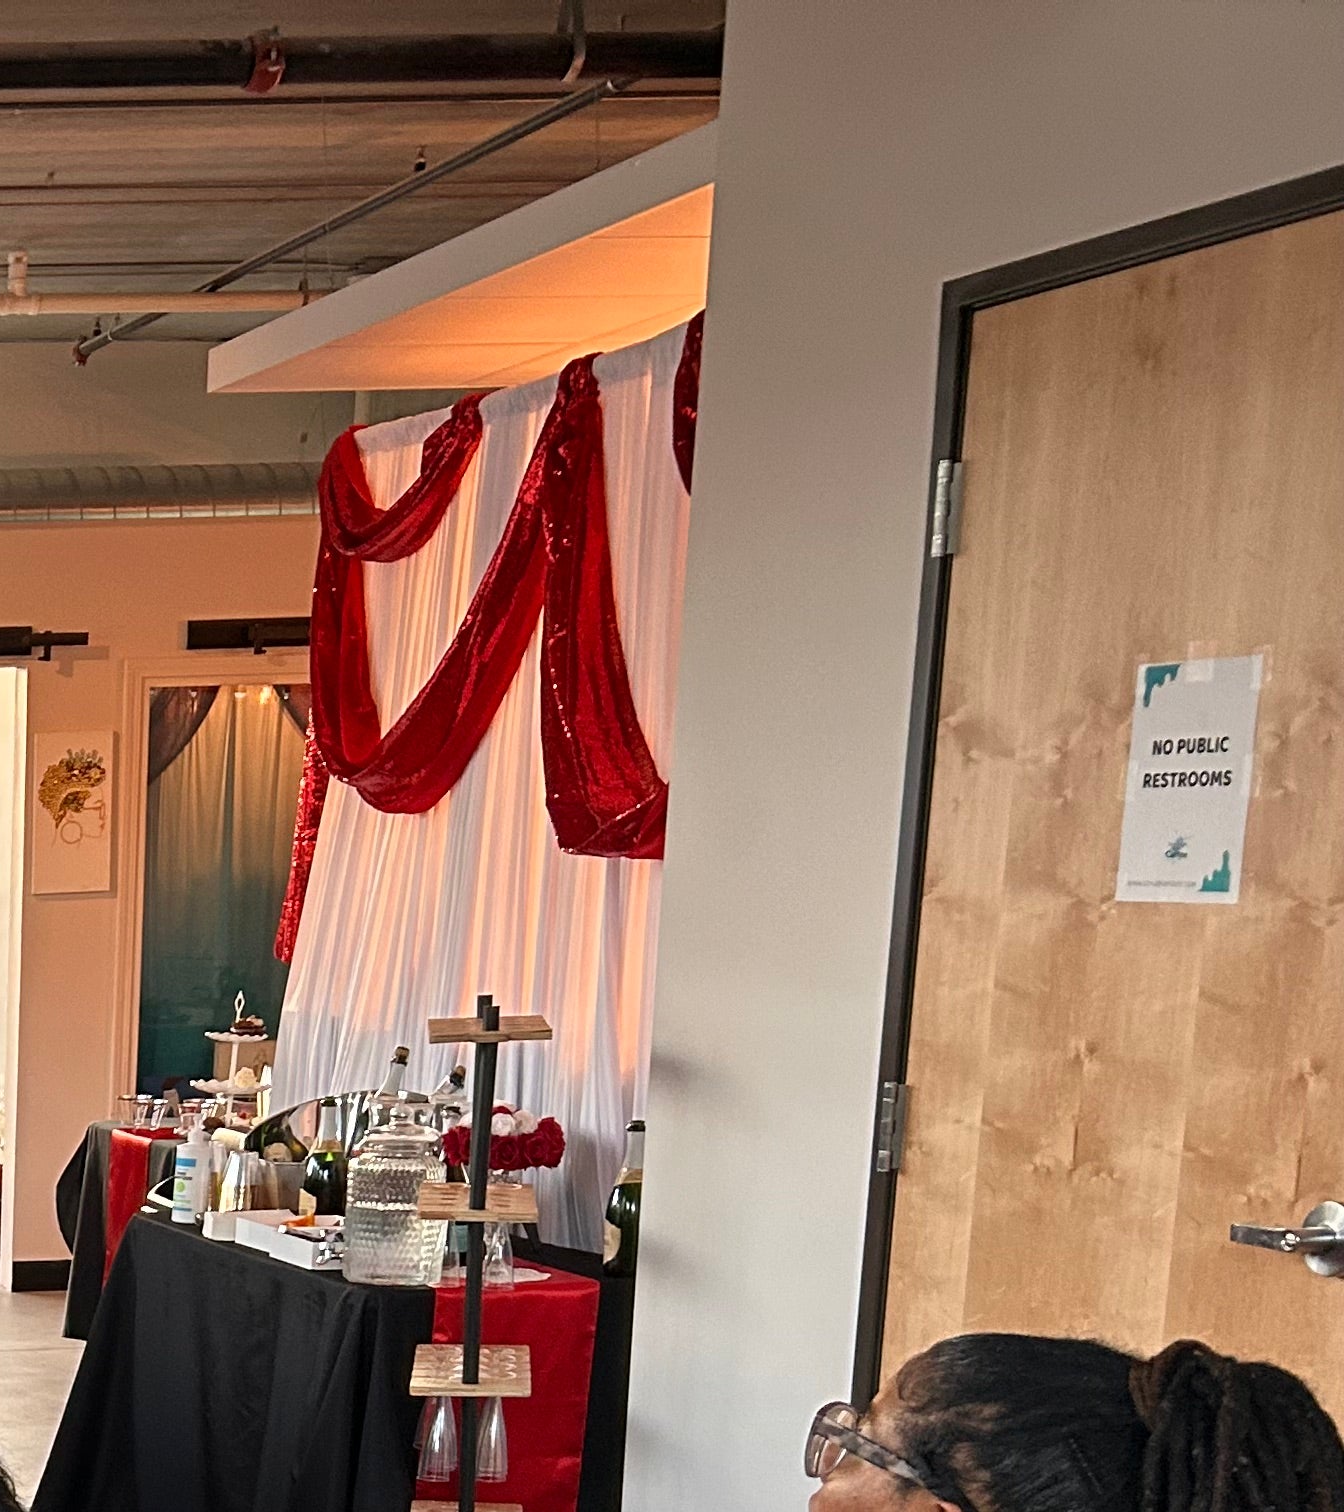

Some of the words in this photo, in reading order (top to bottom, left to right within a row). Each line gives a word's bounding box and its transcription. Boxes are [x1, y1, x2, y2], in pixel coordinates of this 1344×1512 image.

[1152, 739, 1174, 755] NO
[1177, 736, 1230, 754] PUBLIC
[1142, 770, 1232, 788] RESTROOMS
